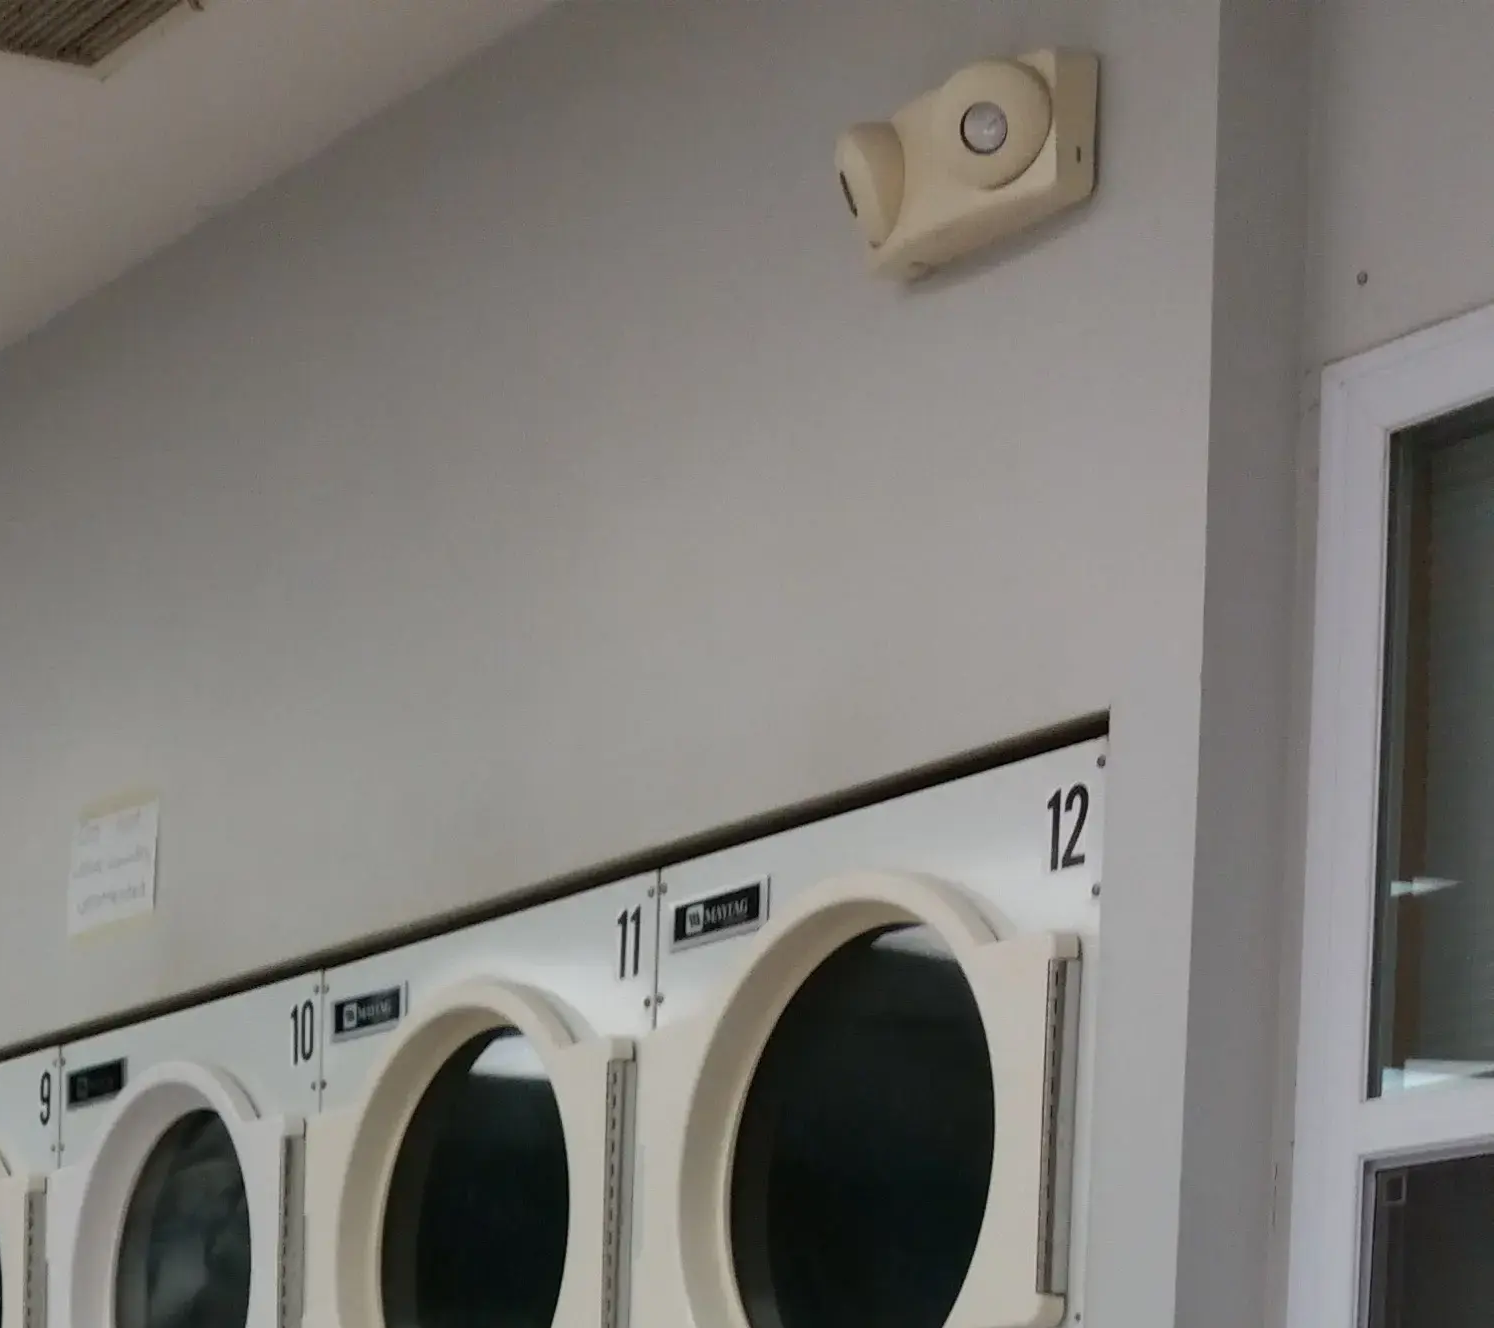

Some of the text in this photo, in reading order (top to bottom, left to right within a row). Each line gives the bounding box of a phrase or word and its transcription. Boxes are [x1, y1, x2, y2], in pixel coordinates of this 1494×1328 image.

[1047, 782, 1089, 872] 12
[617, 903, 641, 979] 11
[291, 999, 314, 1066] 10
[39, 1069, 51, 1126] 9
